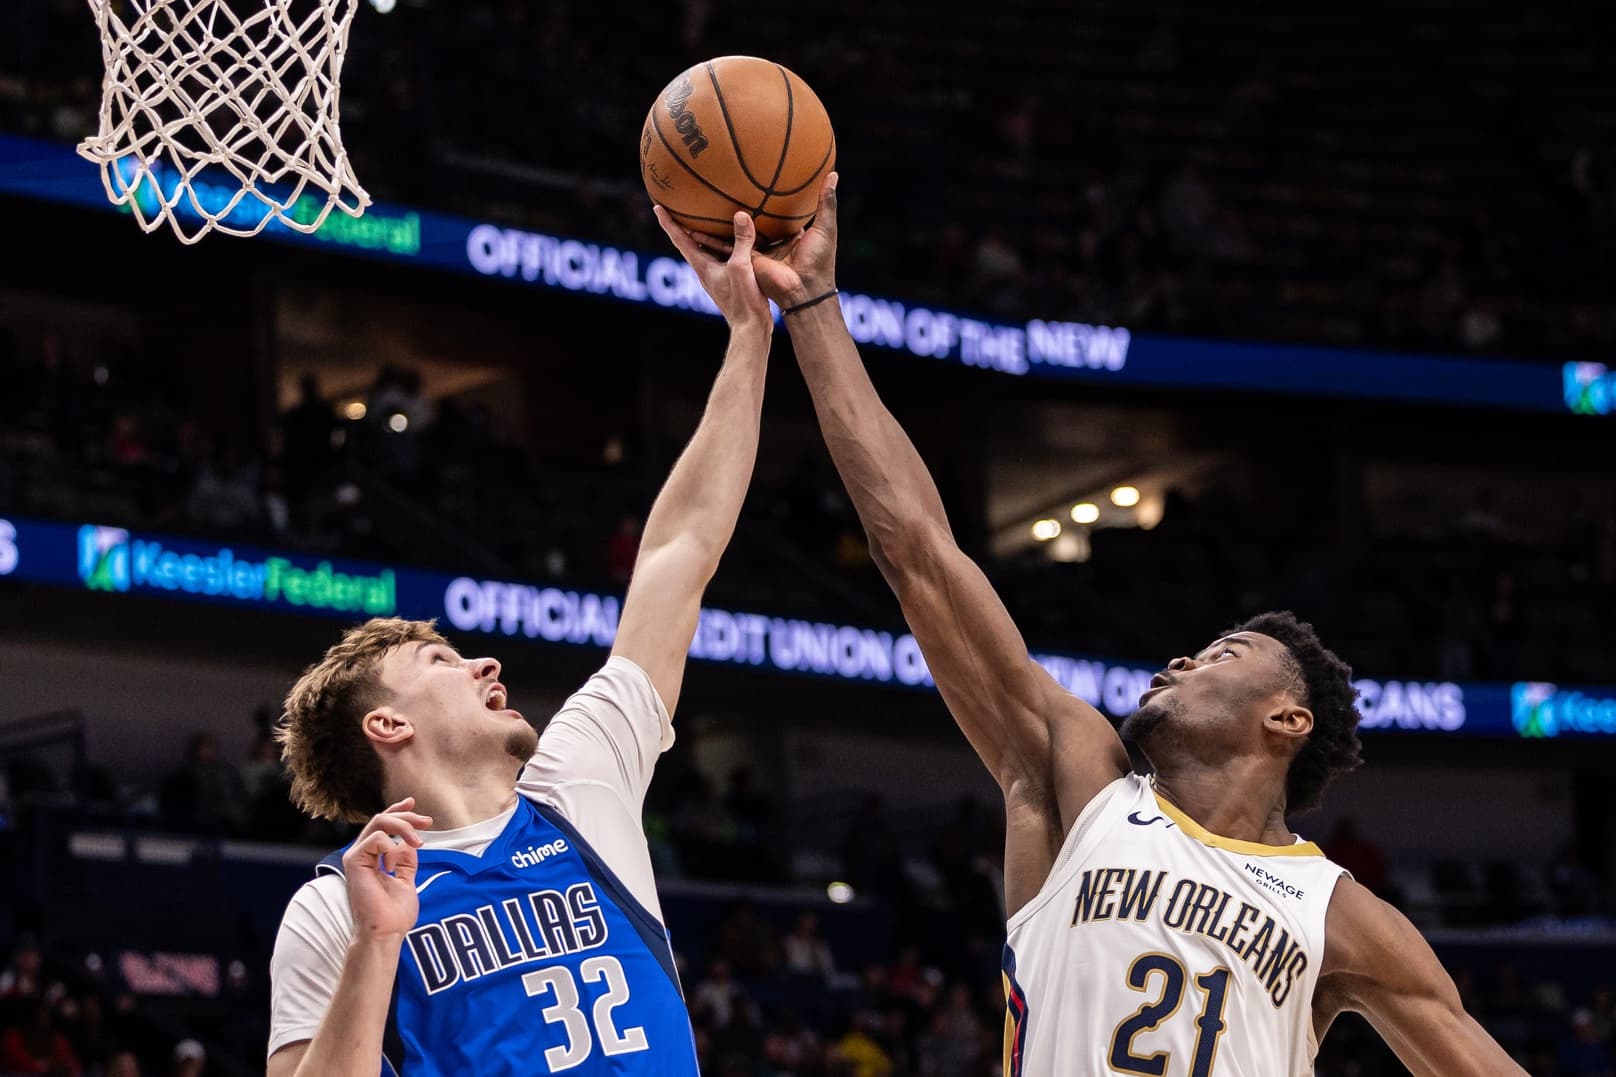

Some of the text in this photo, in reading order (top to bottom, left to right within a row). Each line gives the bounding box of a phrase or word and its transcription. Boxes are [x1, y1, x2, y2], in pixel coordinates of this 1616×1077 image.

[467, 224, 648, 301] OFFICIAL
[905, 308, 960, 359] OF
[960, 318, 1029, 376] THE
[1026, 319, 1131, 371] NEW
[444, 577, 619, 647] OFFICIAL
[688, 608, 770, 665] EDIT
[769, 617, 893, 681] UNION
[1351, 679, 1466, 731] CANS
[511, 838, 569, 868] chime
[1244, 863, 1305, 900] NEWAGE
[1256, 879, 1287, 898] GRILLS
[406, 882, 609, 996] DALLAS
[1070, 868, 1307, 1010] NEW ORLEANS
[521, 955, 650, 1073] 32
[1107, 951, 1233, 1077] 21
